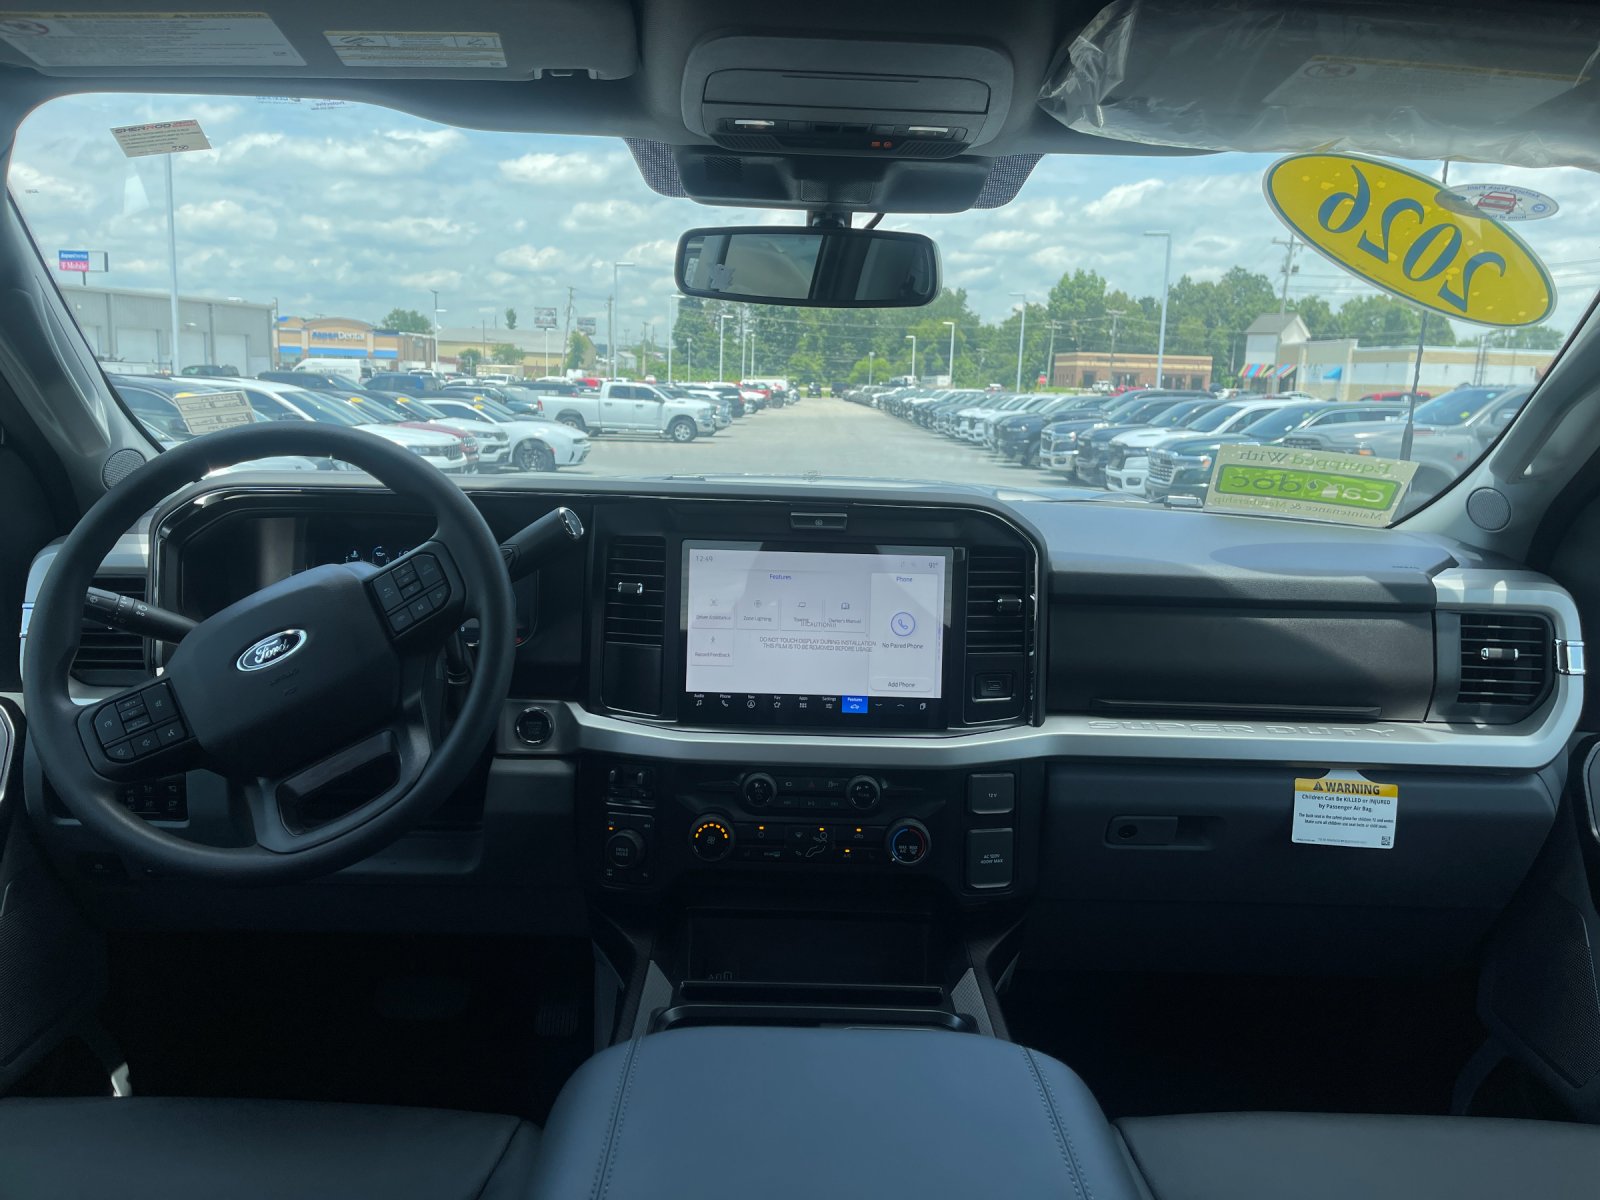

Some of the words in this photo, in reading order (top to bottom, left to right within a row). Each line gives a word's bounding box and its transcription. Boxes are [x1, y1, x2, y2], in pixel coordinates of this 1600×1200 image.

[254, 638, 290, 664] Ford
[1088, 720, 1255, 734] SUPER
[1265, 725, 1395, 737] DUTY
[1326, 782, 1380, 795] WARNING
